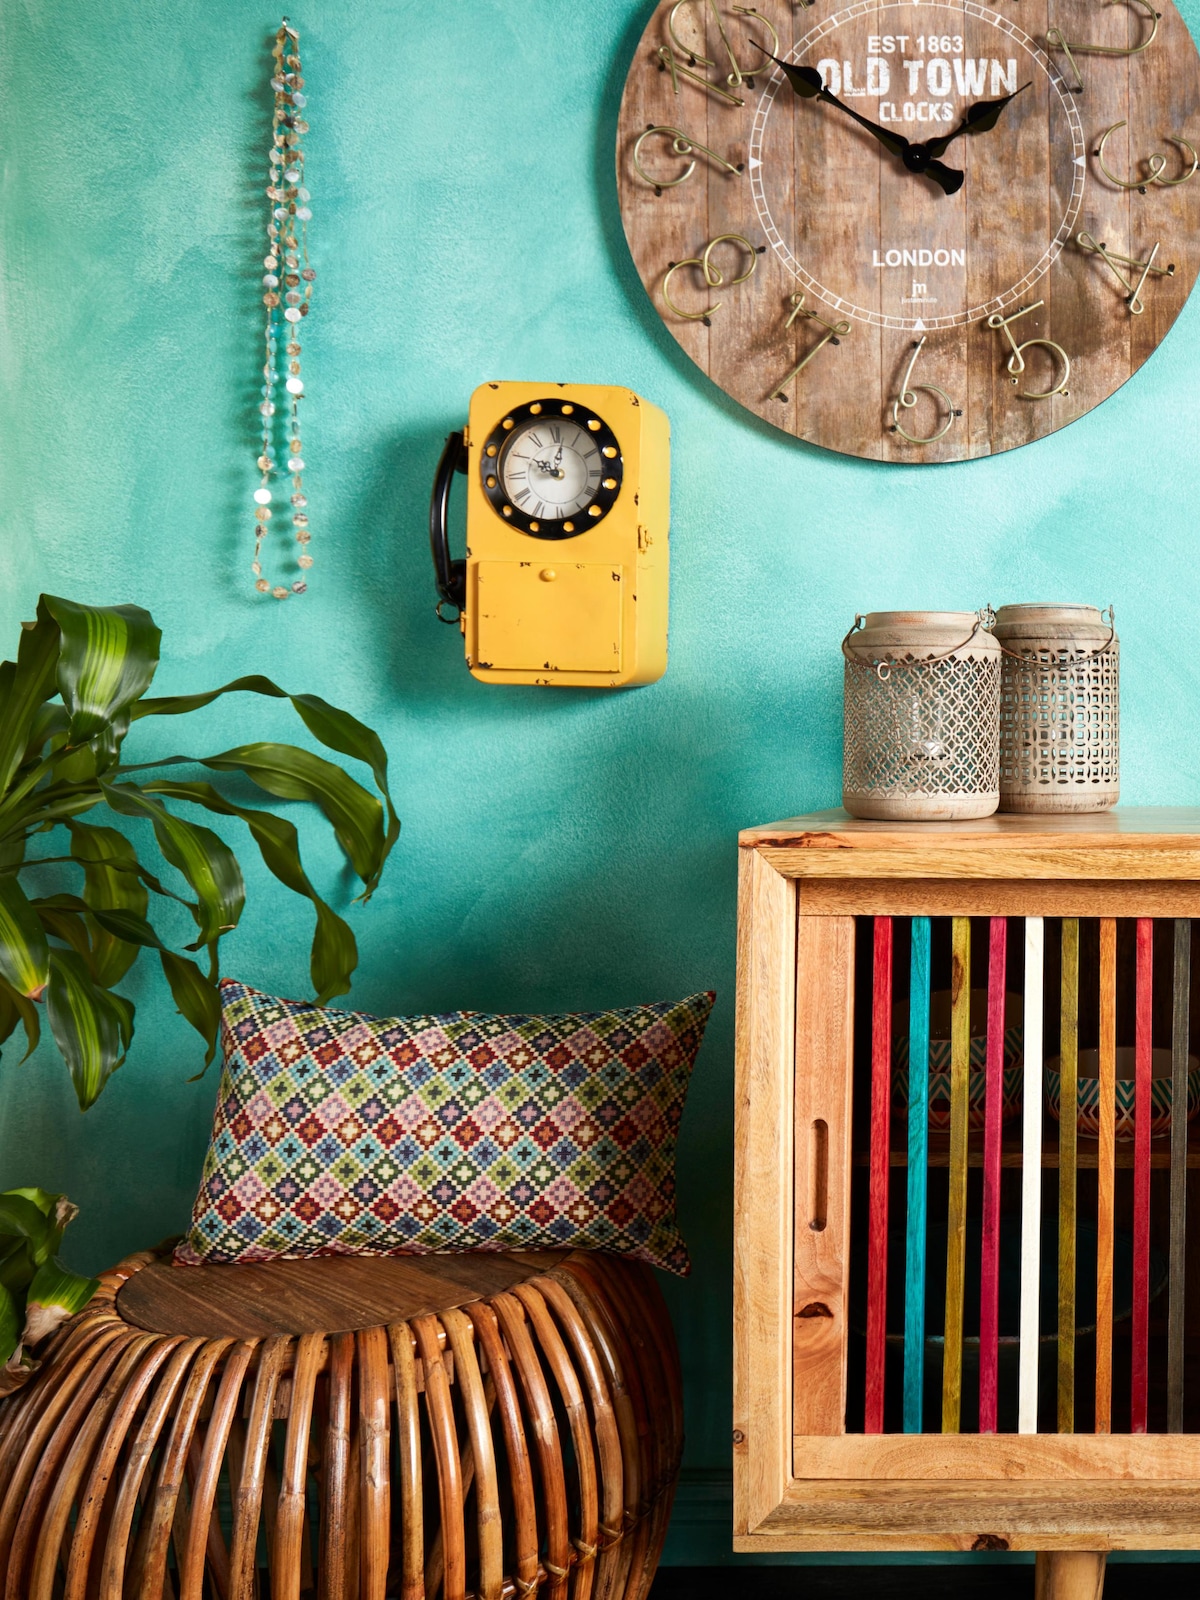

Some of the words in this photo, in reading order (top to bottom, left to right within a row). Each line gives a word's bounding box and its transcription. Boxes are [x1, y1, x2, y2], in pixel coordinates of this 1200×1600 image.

[867, 35, 909, 53] EST
[916, 35, 963, 53] 1863
[816, 56, 890, 97] OLD
[903, 57, 1018, 97] TOWN
[879, 101, 954, 122] CLOCKS
[872, 248, 965, 267] LONDON
